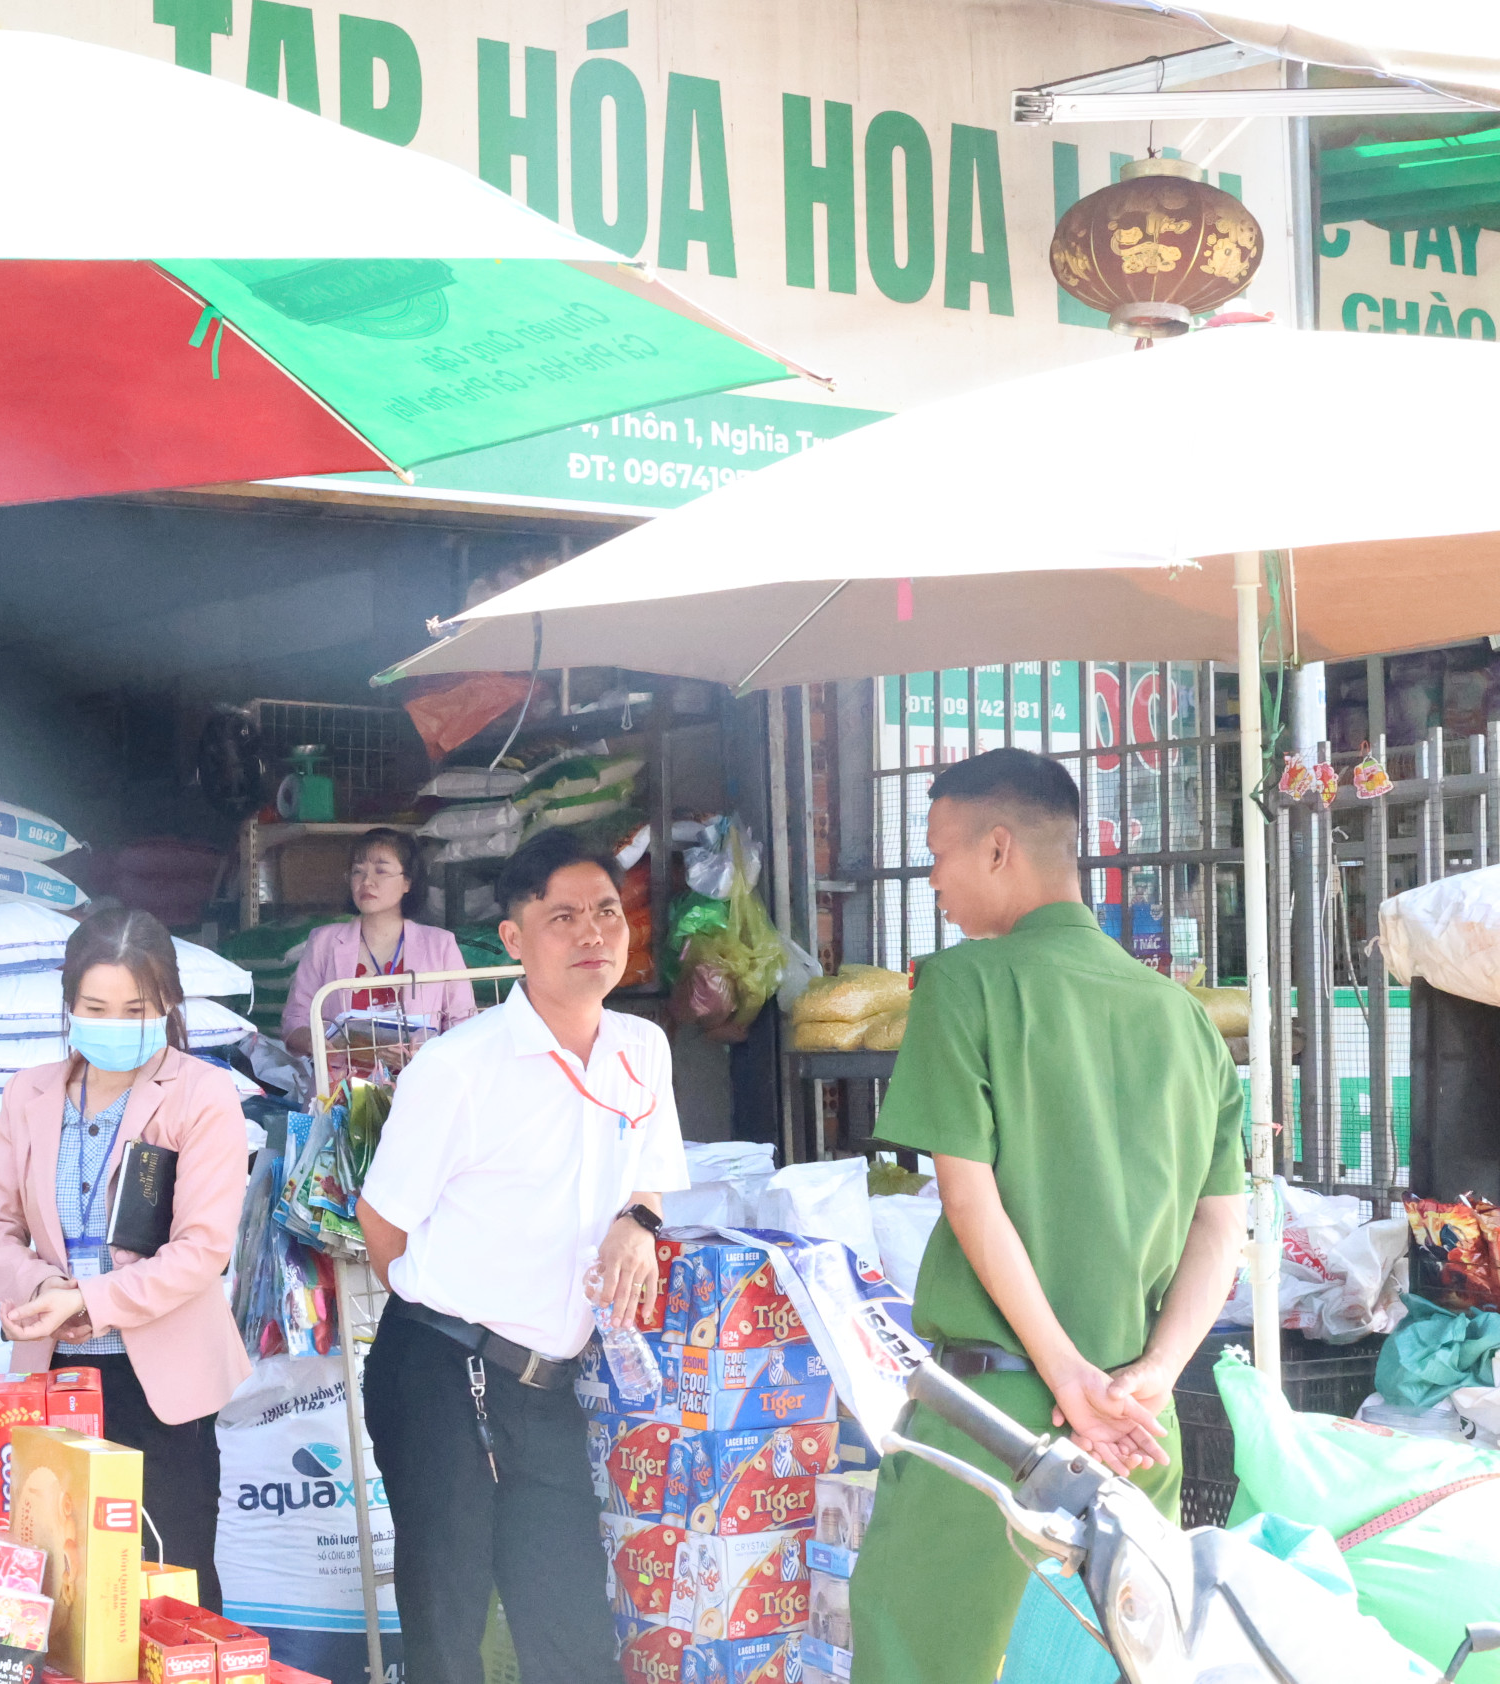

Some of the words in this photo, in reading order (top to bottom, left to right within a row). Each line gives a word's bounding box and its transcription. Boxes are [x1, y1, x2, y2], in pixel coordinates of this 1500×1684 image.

[477, 9, 737, 278] HÓA
[782, 92, 1013, 316] HOA
[1342, 291, 1496, 342] CHÀO
[610, 412, 677, 442] Thôn
[684, 418, 703, 449] 1,
[711, 420, 790, 455] Nghĩa
[567, 452, 616, 482] ĐT:
[28, 826, 59, 844] 8842
[37, 880, 67, 897] Cargill
[726, 1253, 744, 1262] LAGER
[744, 1252, 760, 1261] BEER
[753, 1302, 803, 1340] Tige
[729, 1331, 740, 1342] 24
[725, 1352, 748, 1365] COOL
[724, 1365, 747, 1378] PACK
[682, 1373, 710, 1392] COOL
[679, 1391, 709, 1413] PACK
[759, 1389, 805, 1419] Tiger
[725, 1437, 743, 1447] LAGER
[743, 1435, 759, 1445] BEER
[619, 1446, 666, 1484] Tiger
[750, 1485, 811, 1519] Tiger
[106, 1503, 132, 1527] LU
[727, 1517, 738, 1528] 24
[317, 1534, 339, 1547] Khối
[626, 1549, 673, 1584] Tiger
[759, 1592, 809, 1626] Tige
[735, 1621, 746, 1631] 24
[738, 1644, 754, 1655] LAGER
[754, 1642, 770, 1653] BEER
[168, 1658, 209, 1673] tingco
[223, 1651, 264, 1668] tingco
[630, 1650, 680, 1684] Tiger
